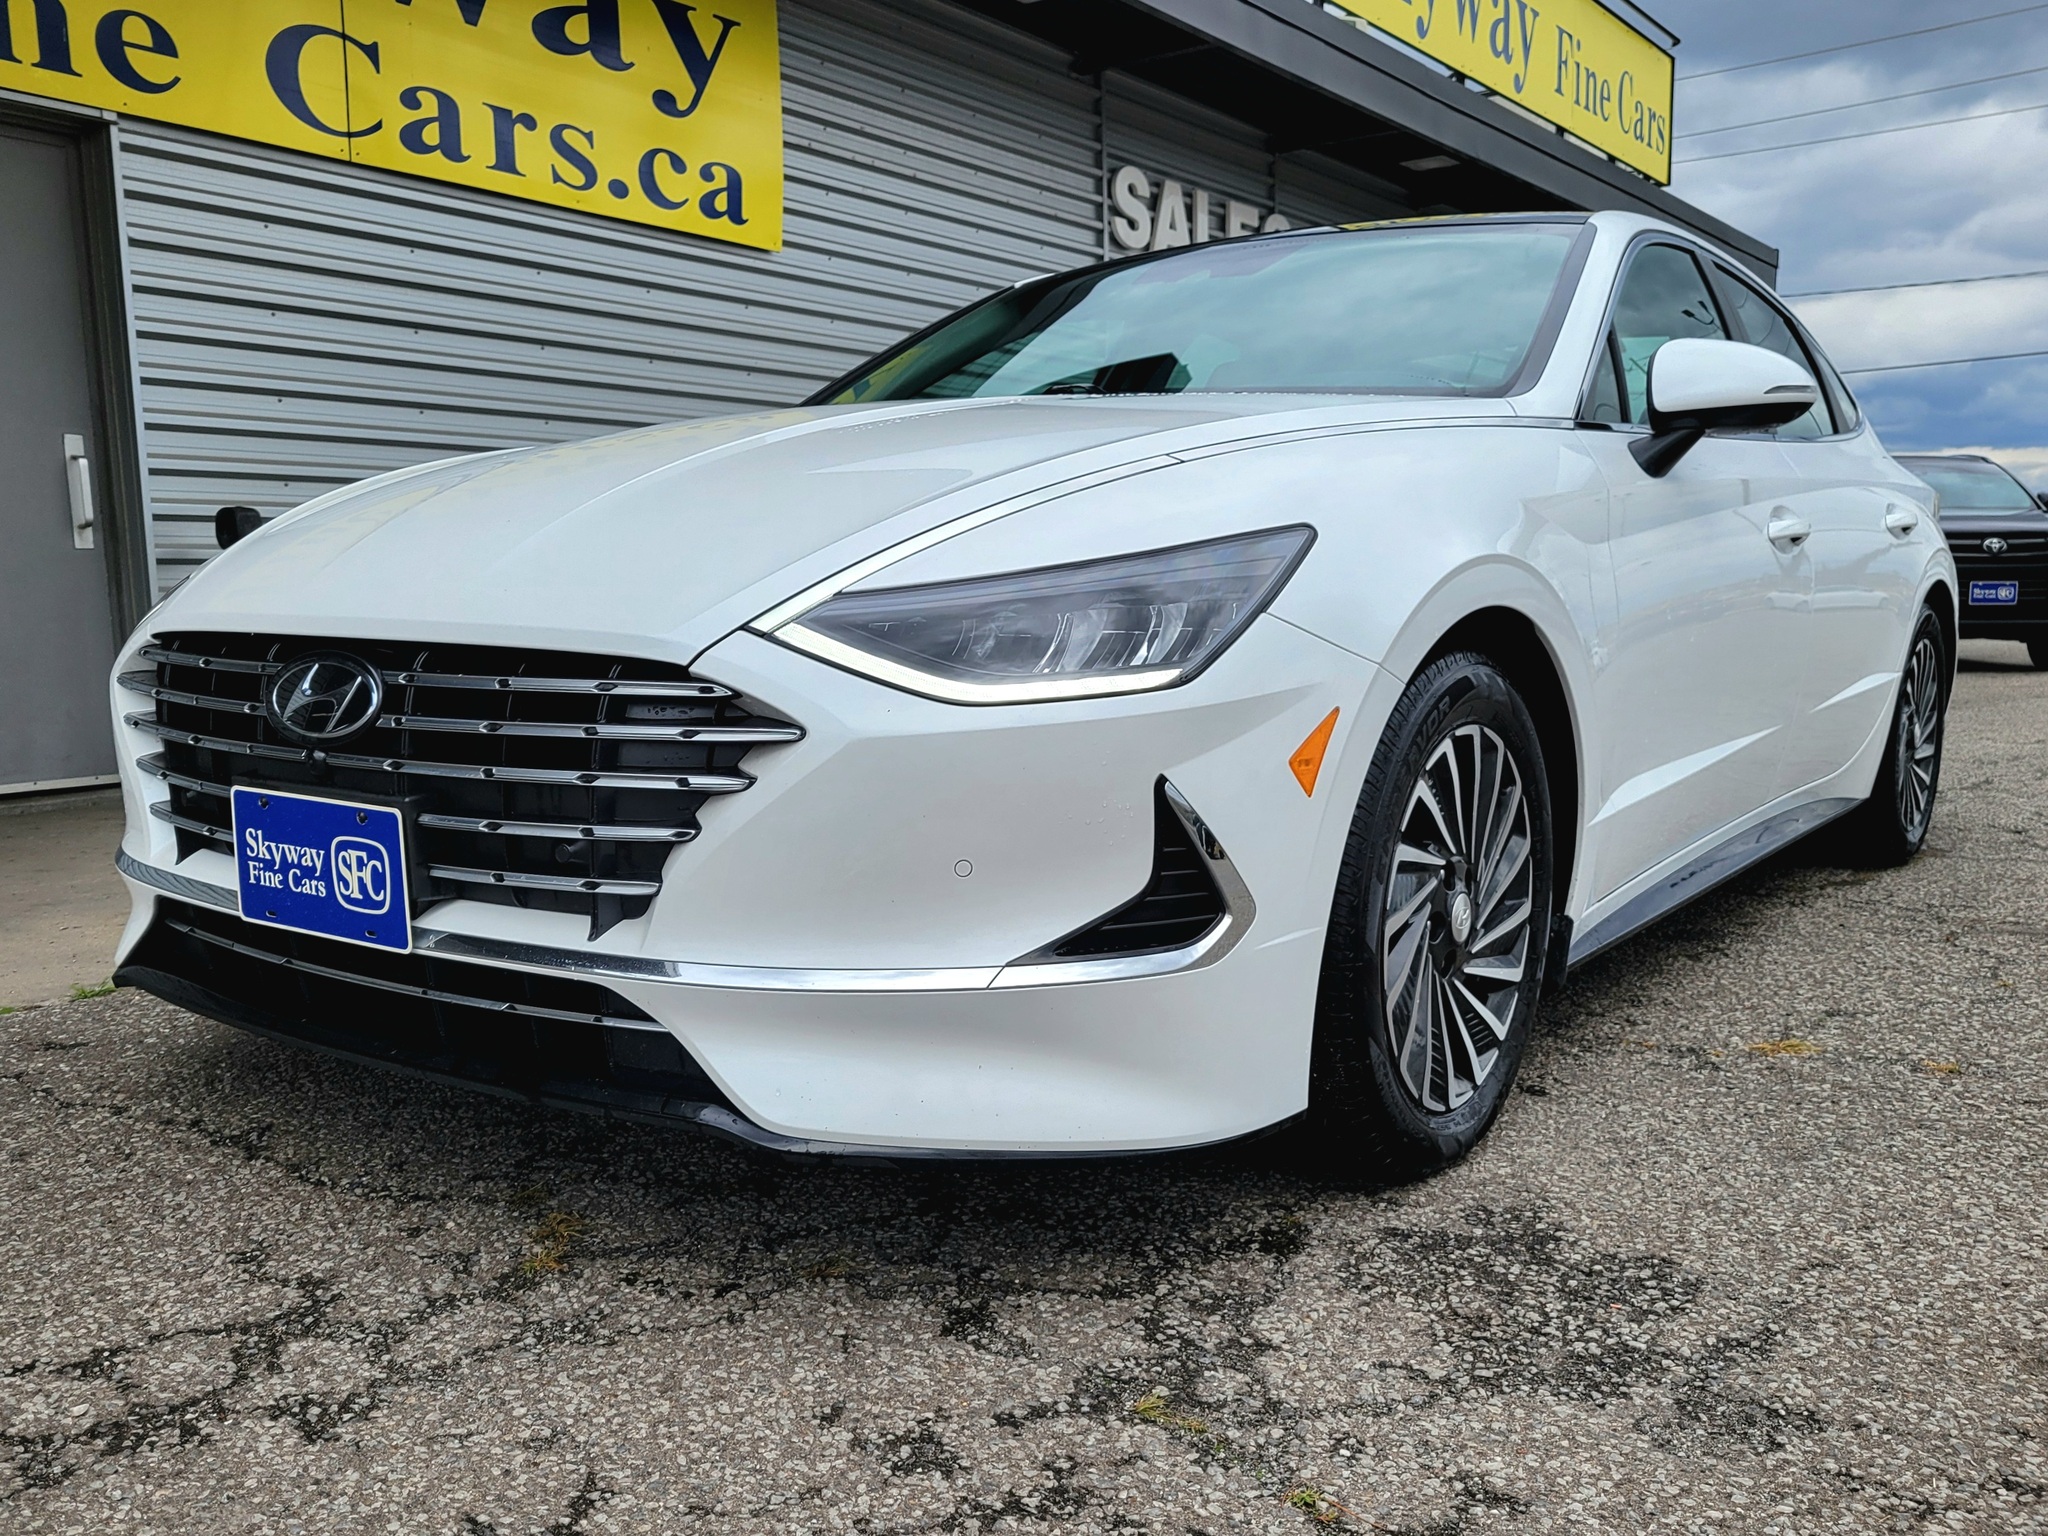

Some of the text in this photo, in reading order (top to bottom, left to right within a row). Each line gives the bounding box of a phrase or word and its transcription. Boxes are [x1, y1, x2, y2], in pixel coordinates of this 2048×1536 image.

[265, 23, 749, 226] Cars.ca
[1554, 24, 1611, 123] Fine
[1616, 69, 1666, 156] Cars
[1110, 165, 1291, 252] SALE
[245, 828, 325, 876] Skyway
[248, 861, 327, 897] Fine Cars
[338, 849, 384, 901] SFC
